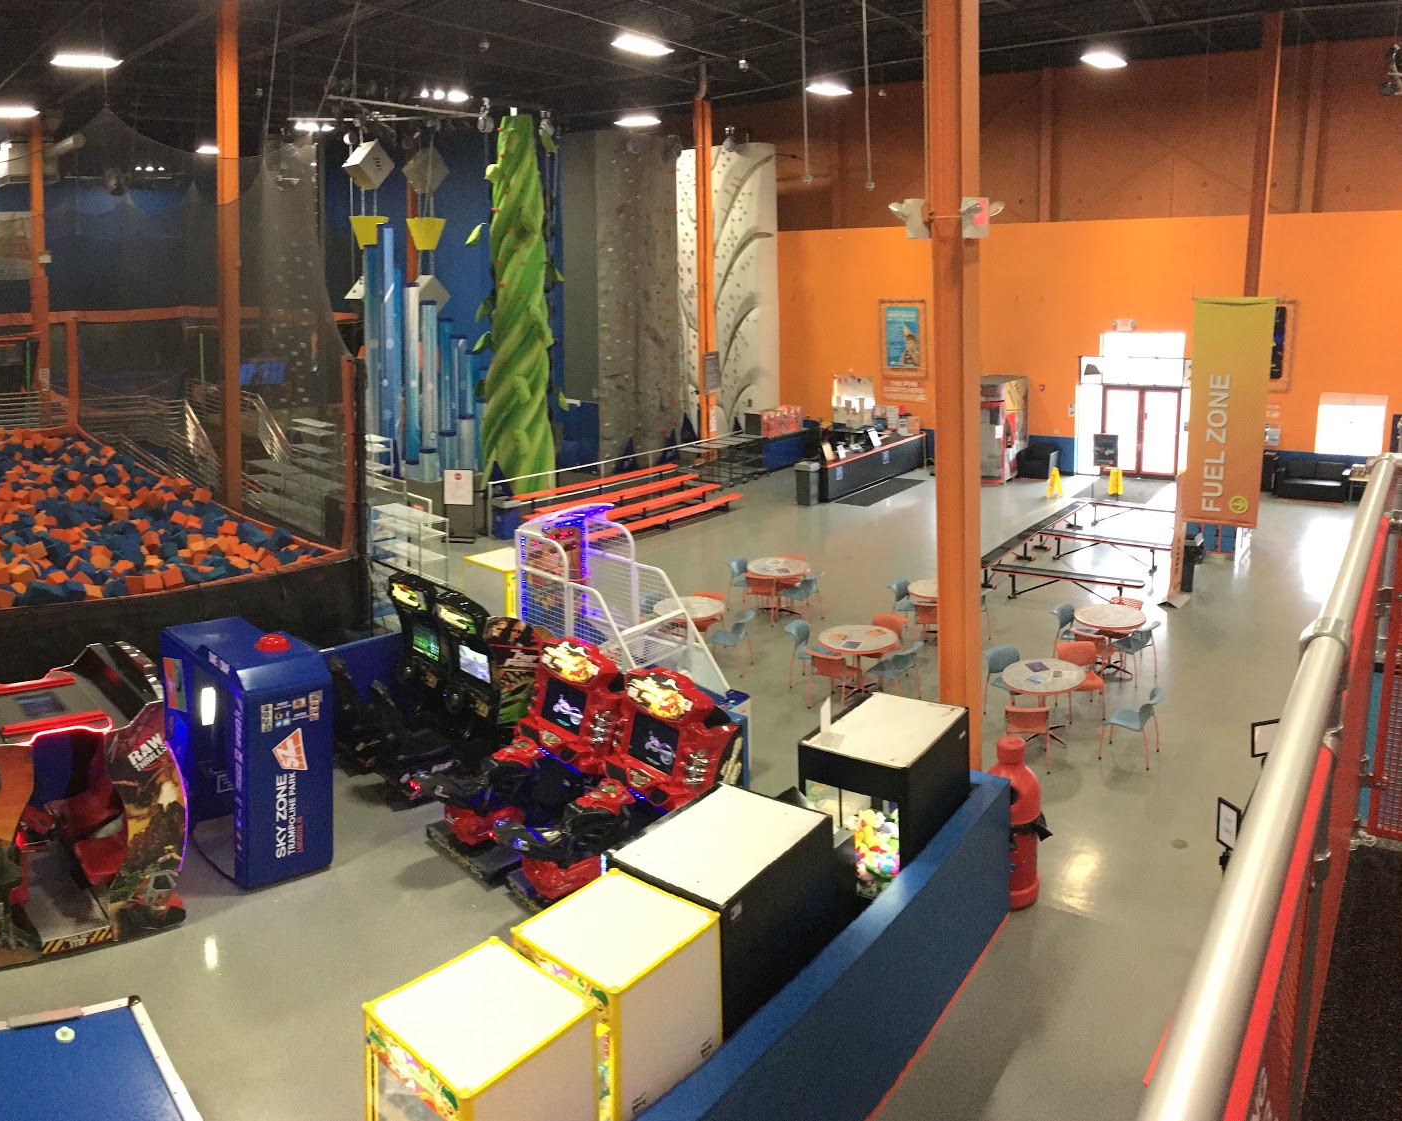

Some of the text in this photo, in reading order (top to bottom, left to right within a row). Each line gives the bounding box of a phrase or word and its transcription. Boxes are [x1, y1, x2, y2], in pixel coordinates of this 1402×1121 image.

[1201, 374, 1231, 513] FUEL ZONE
[128, 733, 163, 767] RAW
[277, 738, 300, 768] SZ
[275, 773, 288, 858] SKY ZONE
[287, 771, 297, 855] TRAMPOLINE PARK
